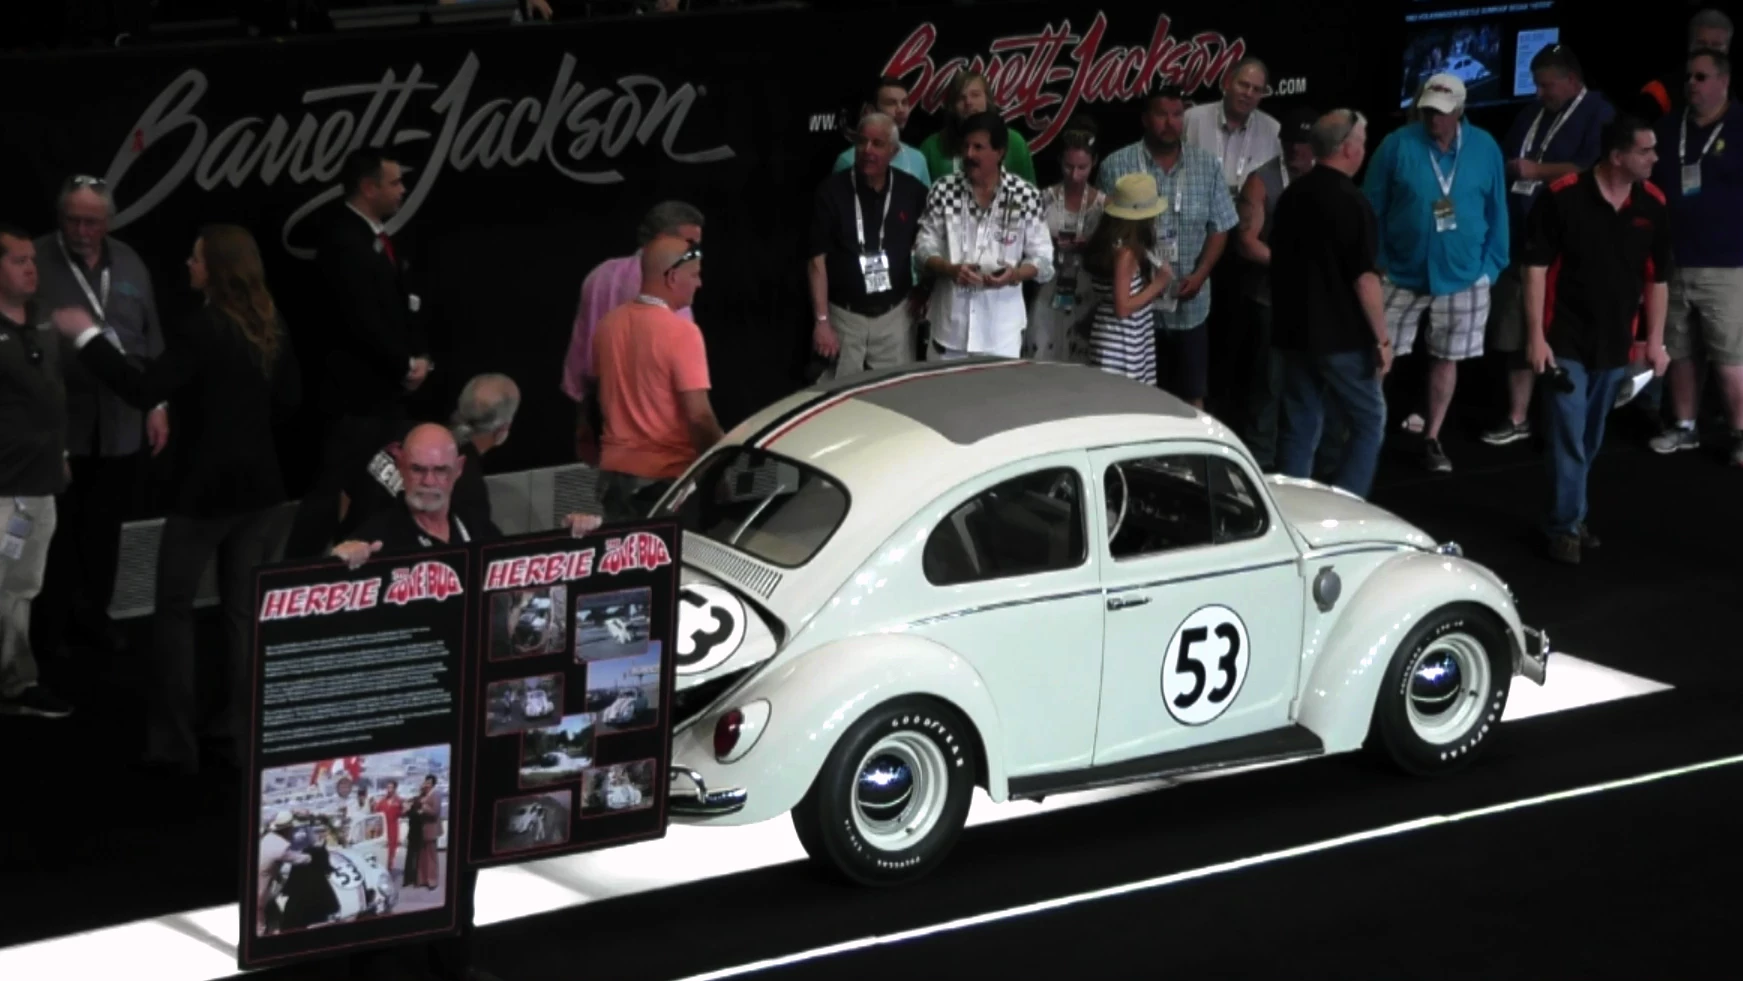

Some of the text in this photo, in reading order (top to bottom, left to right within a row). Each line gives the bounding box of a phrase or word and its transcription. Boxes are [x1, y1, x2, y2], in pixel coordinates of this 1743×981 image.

[104, 50, 736, 259] Barrett-Jackson
[484, 547, 596, 592] HERBIE
[597, 532, 672, 576] LOVE BUG
[259, 577, 382, 621] HERBIE
[383, 561, 464, 605] LOVE BUG
[1173, 621, 1241, 709] 53
[335, 863, 362, 886] 53
